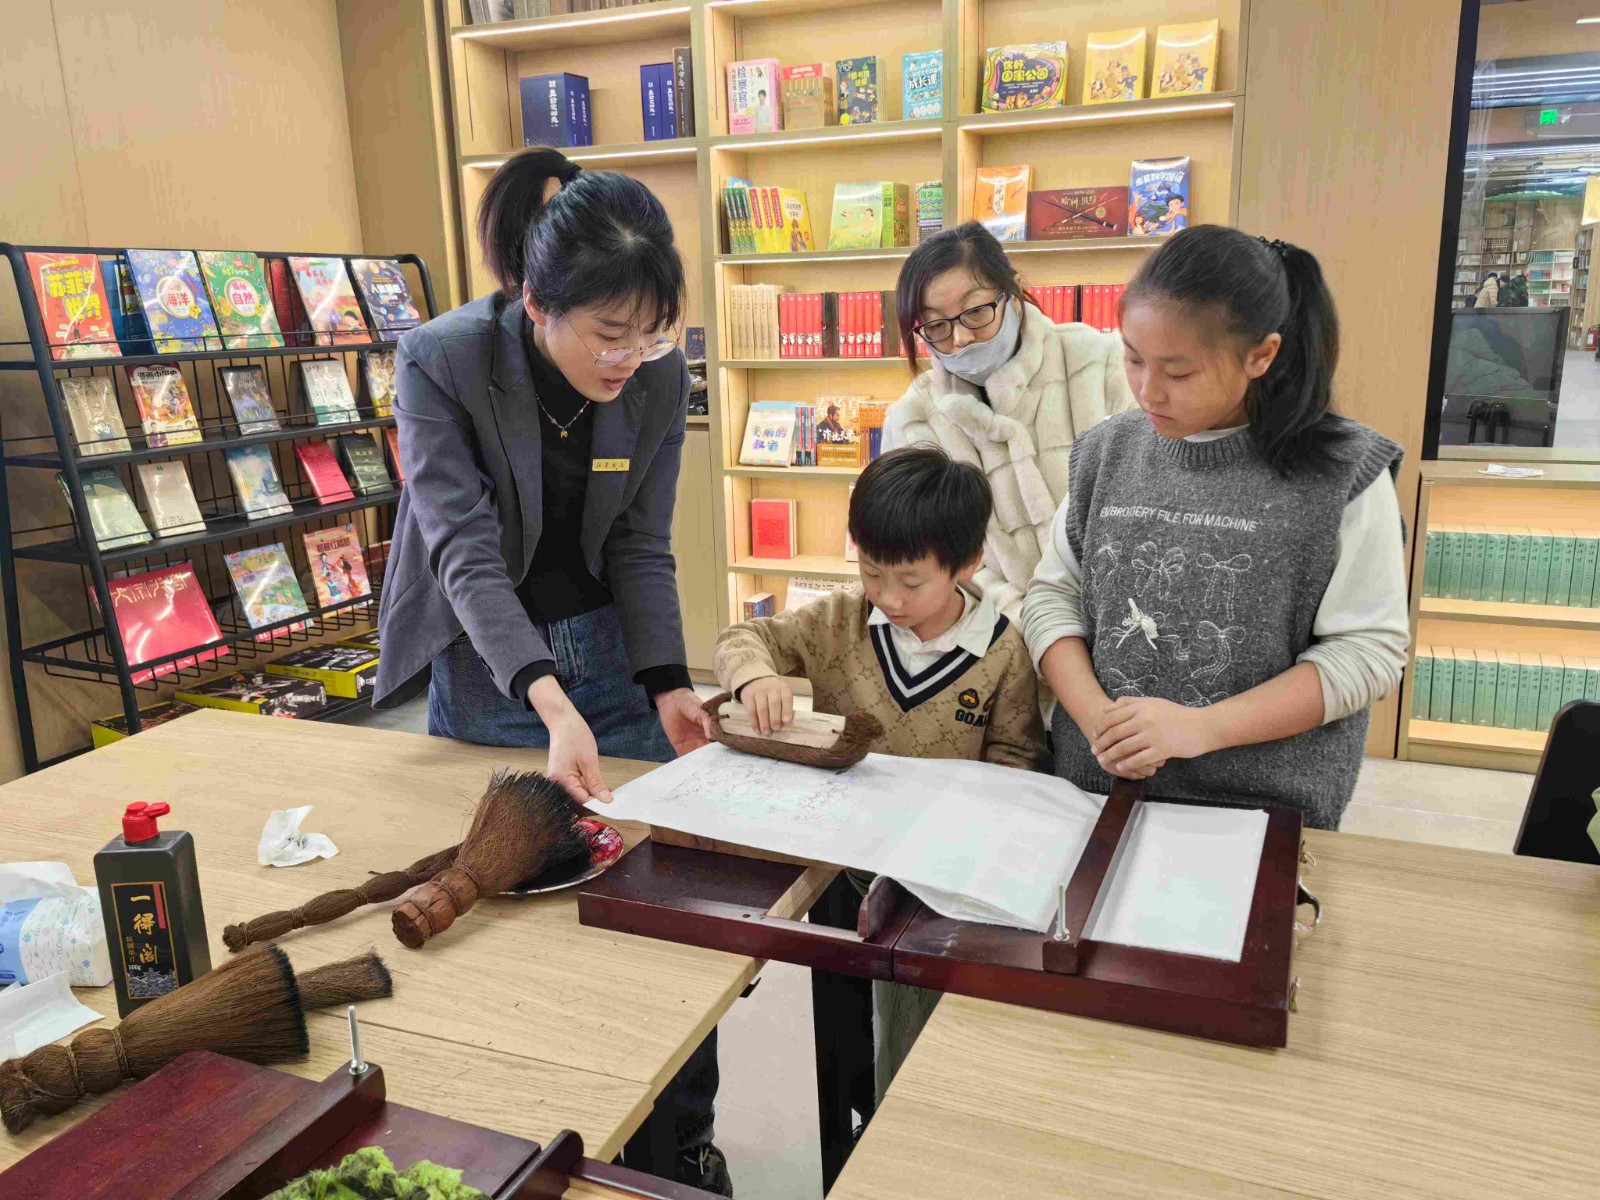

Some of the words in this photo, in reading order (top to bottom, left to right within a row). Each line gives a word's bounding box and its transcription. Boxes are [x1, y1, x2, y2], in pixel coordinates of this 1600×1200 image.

[1001, 67, 1049, 83] 国家公园
[46, 270, 95, 298] 苏菲的
[166, 293, 190, 306] 海洋
[232, 292, 256, 305] 自然
[65, 293, 101, 321] 世界
[751, 424, 787, 438] 美丽的
[752, 439, 779, 453] 汉字
[1157, 509, 1181, 523] FILE
[1182, 513, 1203, 526] FOR
[1204, 513, 1259, 533] MACHINE
